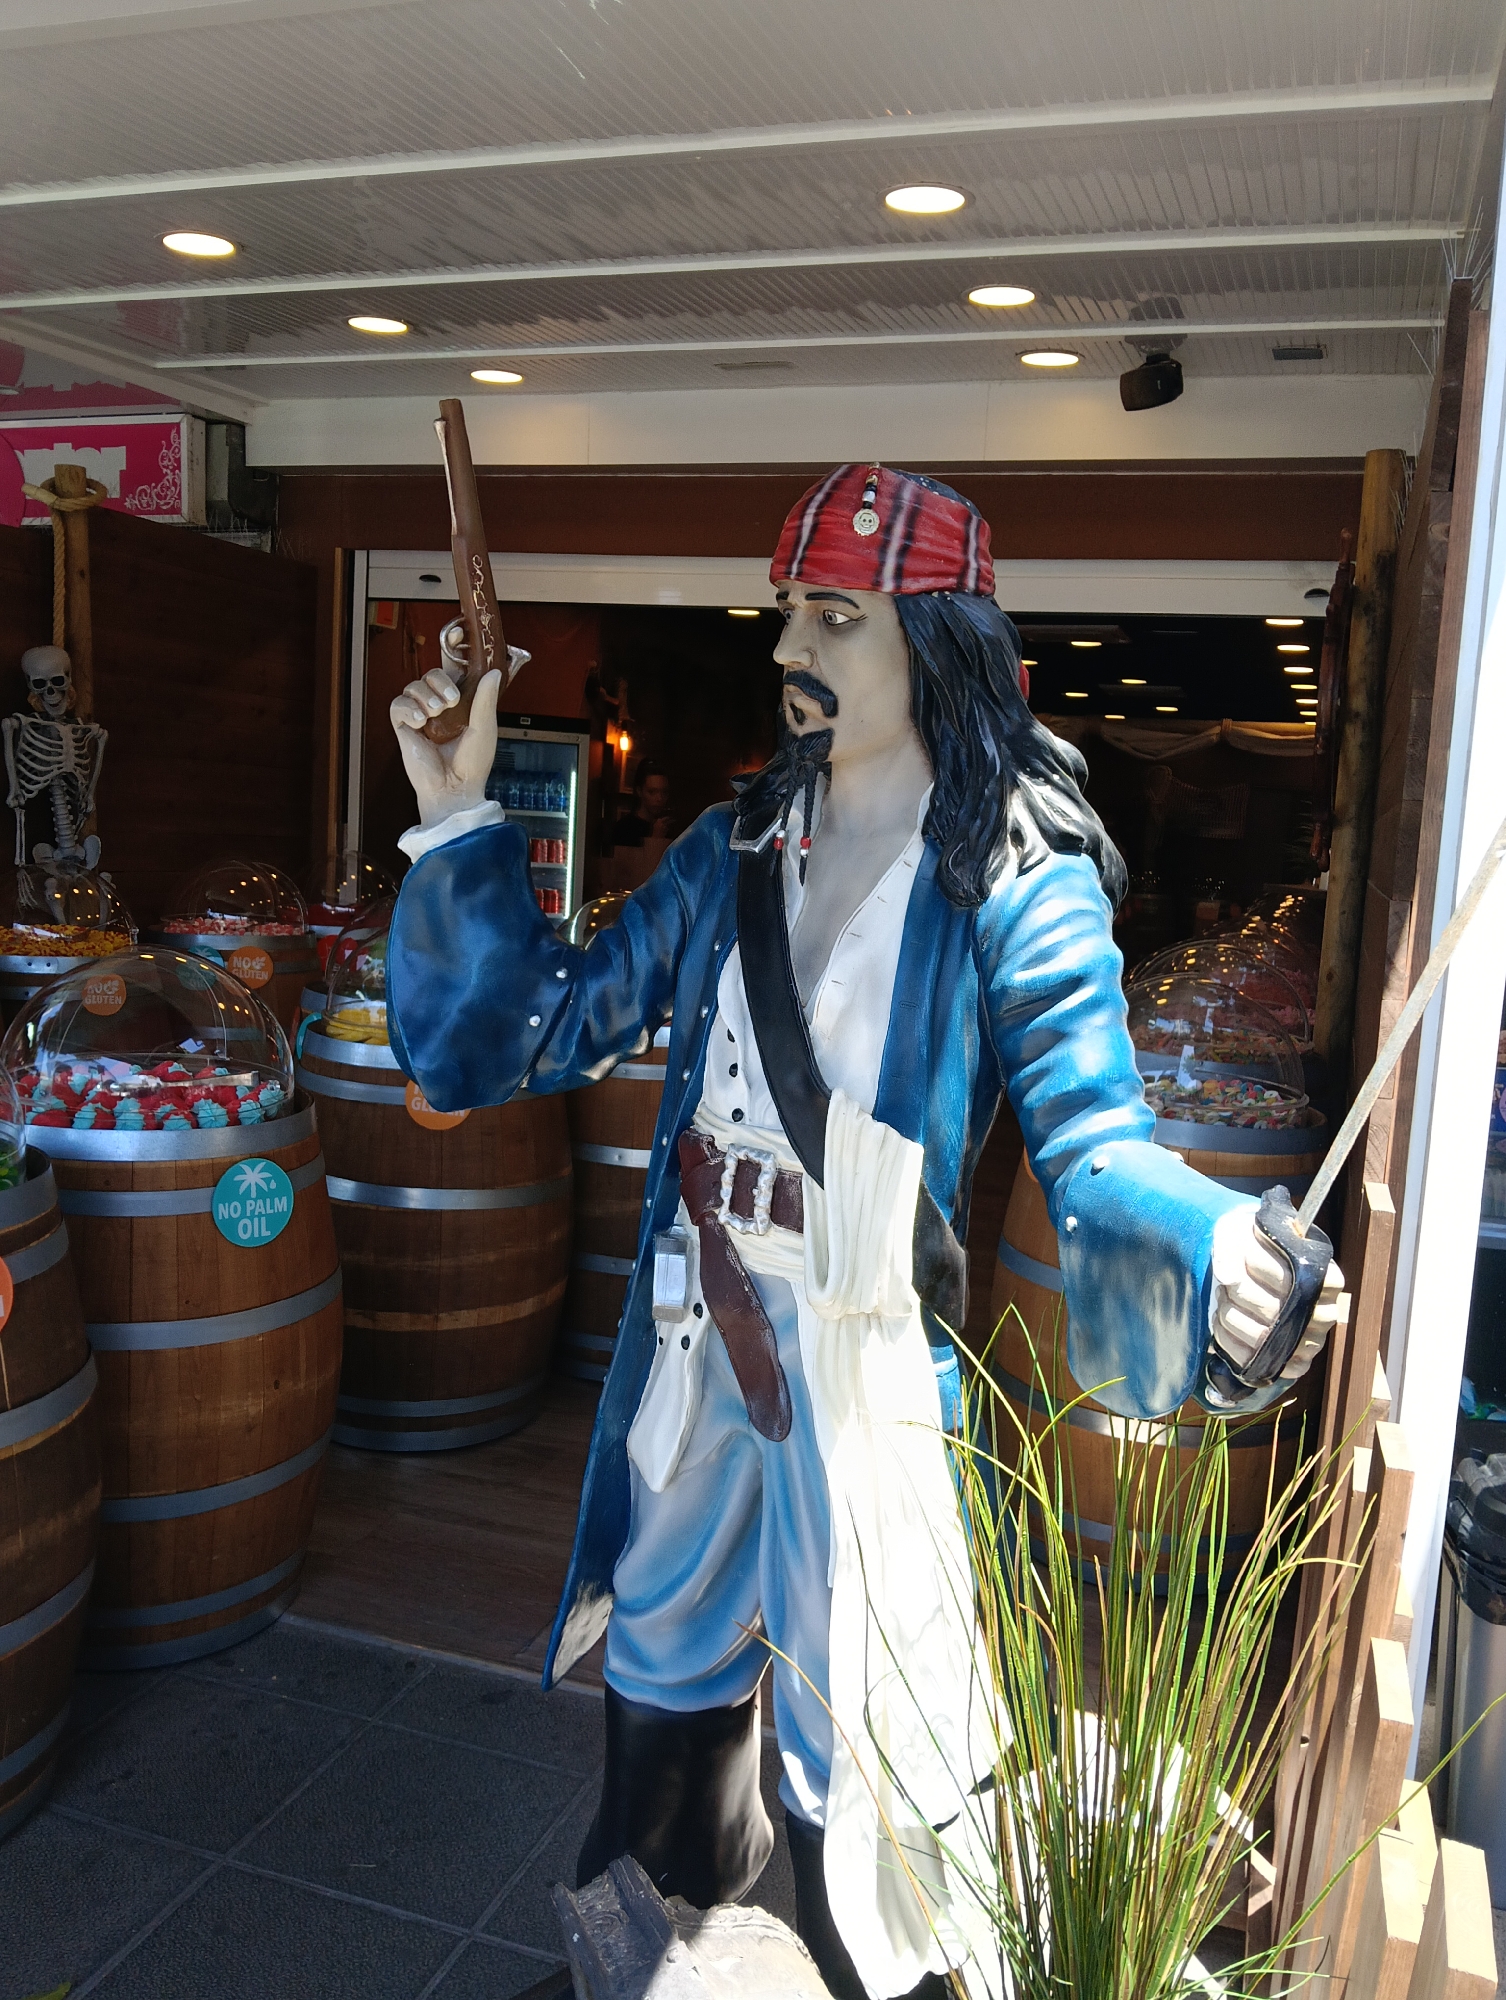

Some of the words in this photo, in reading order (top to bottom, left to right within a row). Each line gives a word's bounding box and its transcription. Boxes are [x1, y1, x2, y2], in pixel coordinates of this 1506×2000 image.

[232, 956, 251, 969] NO
[232, 968, 269, 980] GLUTEN
[84, 994, 122, 1005] GLUTEN
[218, 1201, 242, 1220] NO
[246, 1196, 288, 1217] PALM
[237, 1217, 271, 1240] OIL
